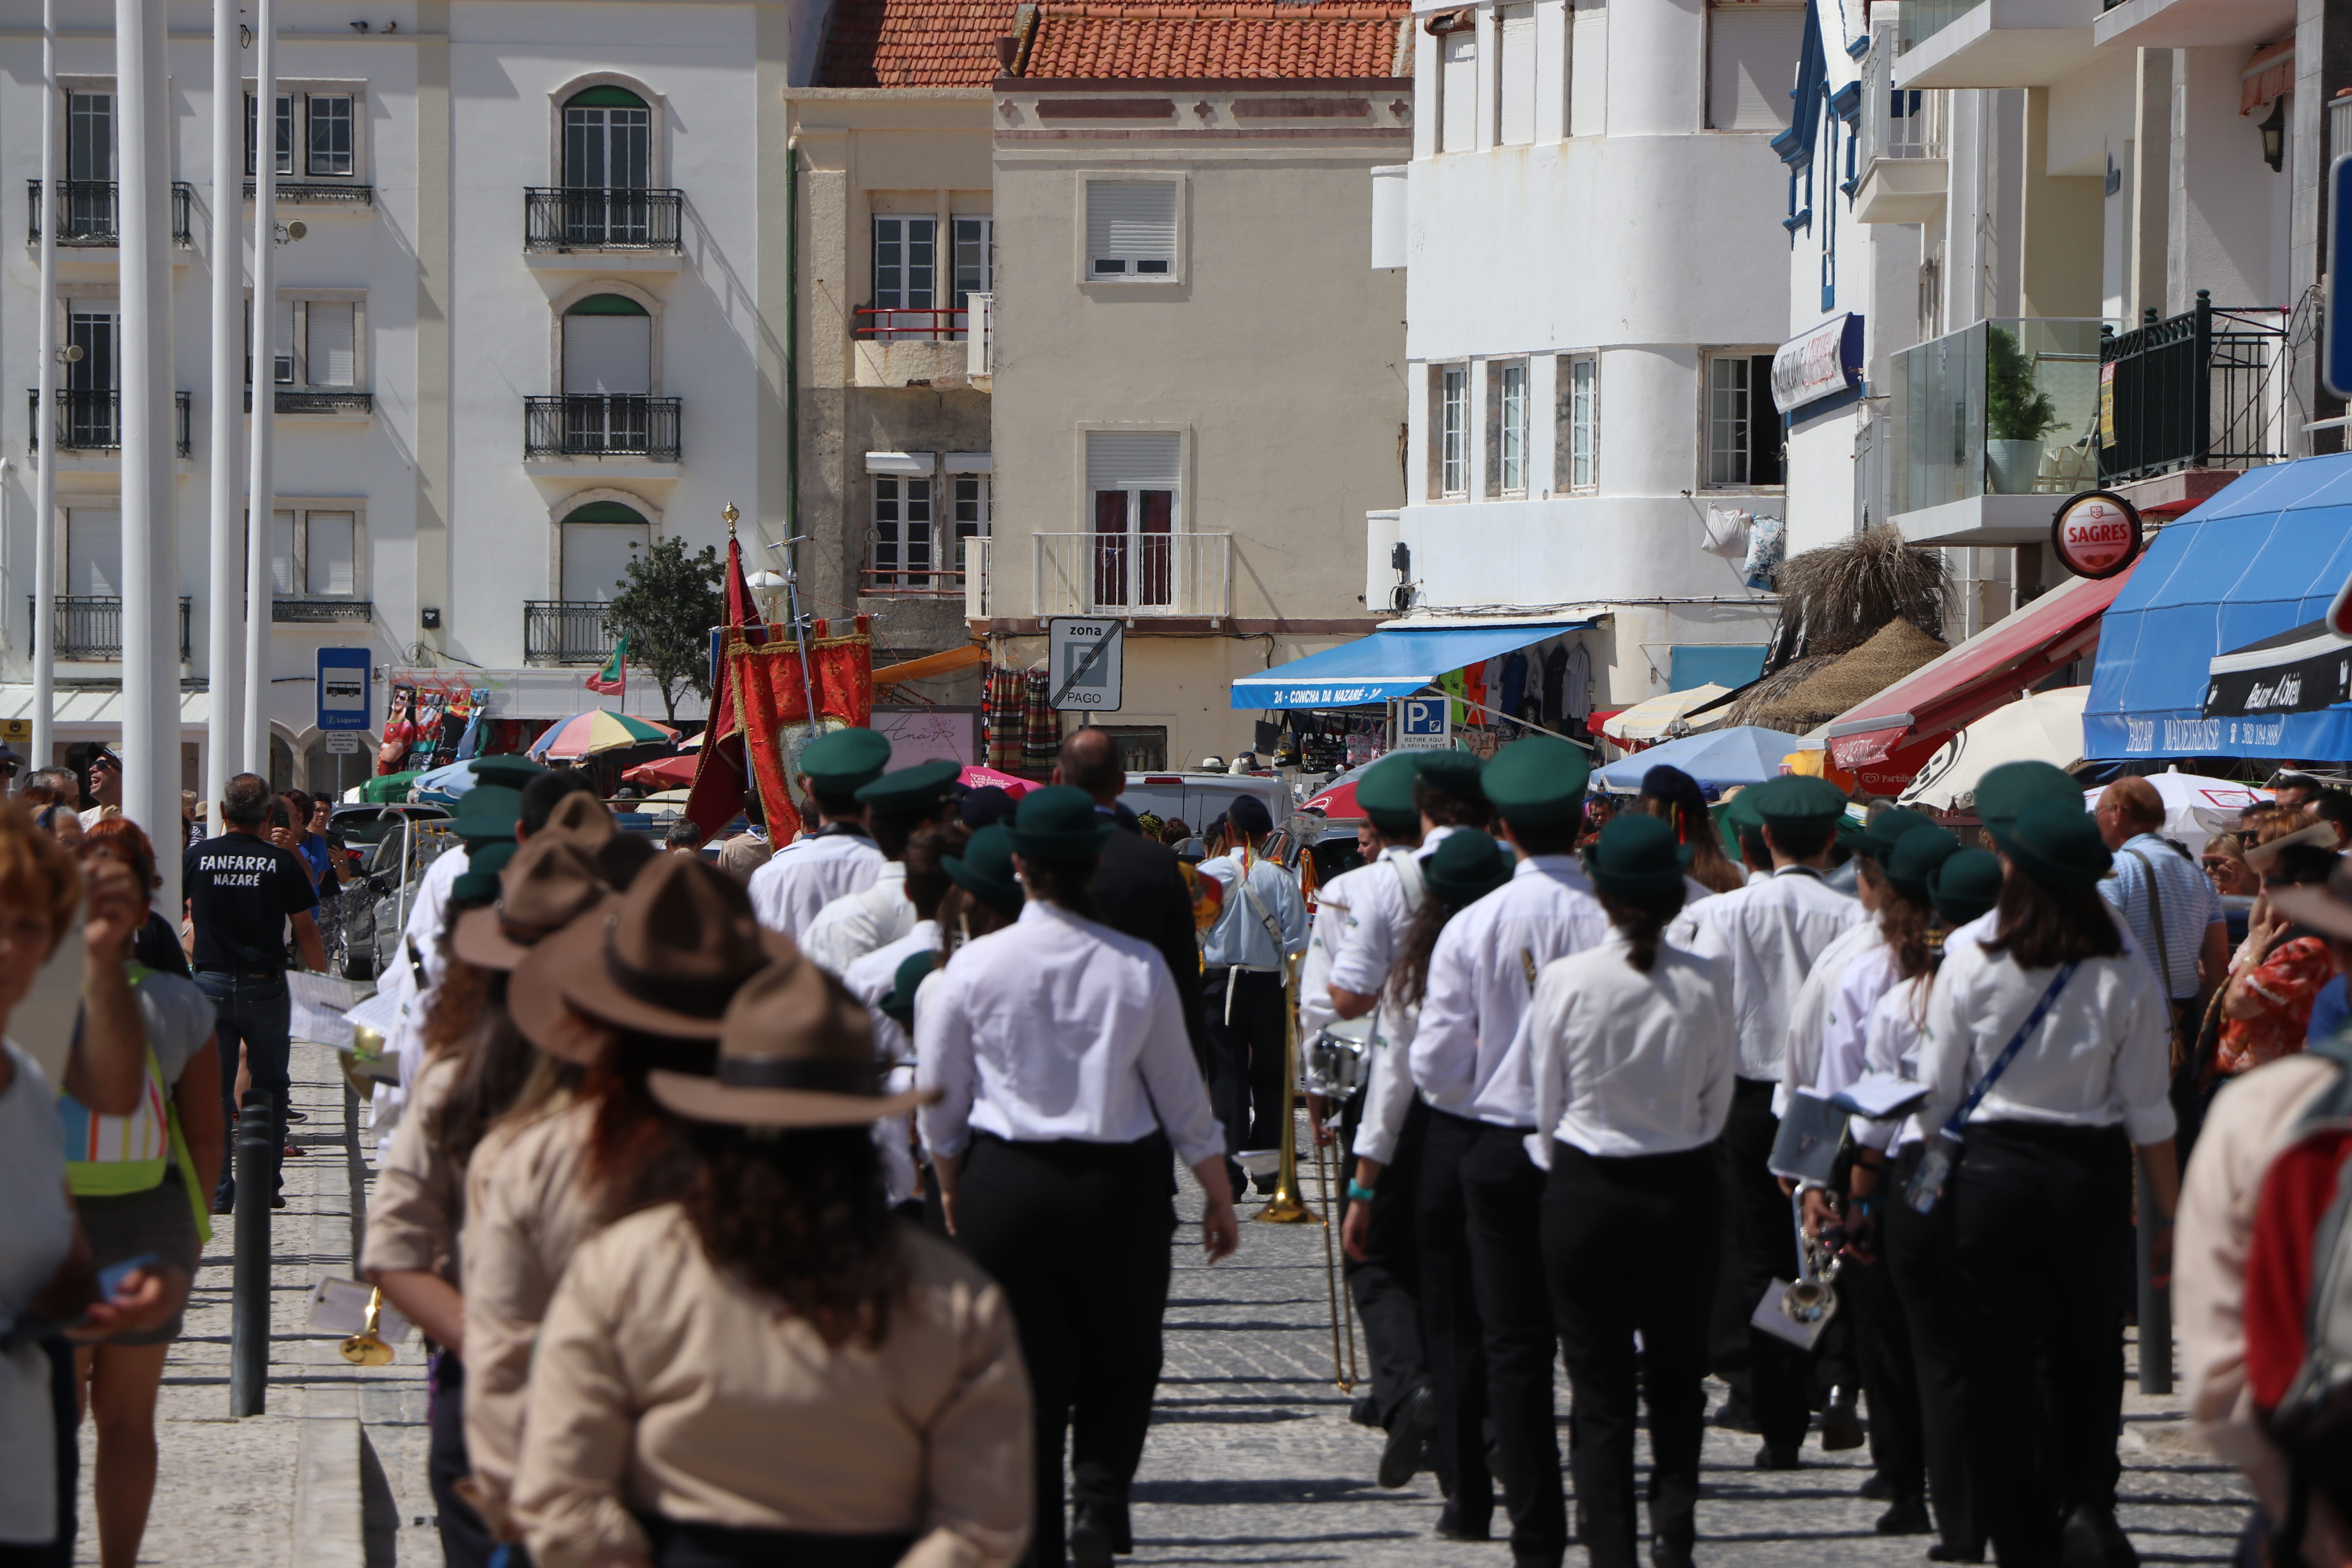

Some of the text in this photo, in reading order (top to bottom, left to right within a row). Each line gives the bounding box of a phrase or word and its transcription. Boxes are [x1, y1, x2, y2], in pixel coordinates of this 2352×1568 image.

[2069, 524, 2127, 543] SAGRES
[1070, 626, 1102, 636] zona
[1067, 692, 1101, 703] PAGO
[1274, 690, 1283, 703] 24
[1290, 690, 1319, 703] CONCHA
[1321, 690, 1332, 702] DA
[1333, 686, 1365, 702] NAZARÉ
[1408, 702, 1428, 732] P
[878, 713, 931, 740] Ana
[2126, 720, 2154, 751] BAZAR
[2162, 719, 2220, 750] MADEIRENSE
[2242, 723, 2254, 744] 262
[200, 855, 276, 873] FANFARRA
[214, 873, 260, 886] NAZARÉ
